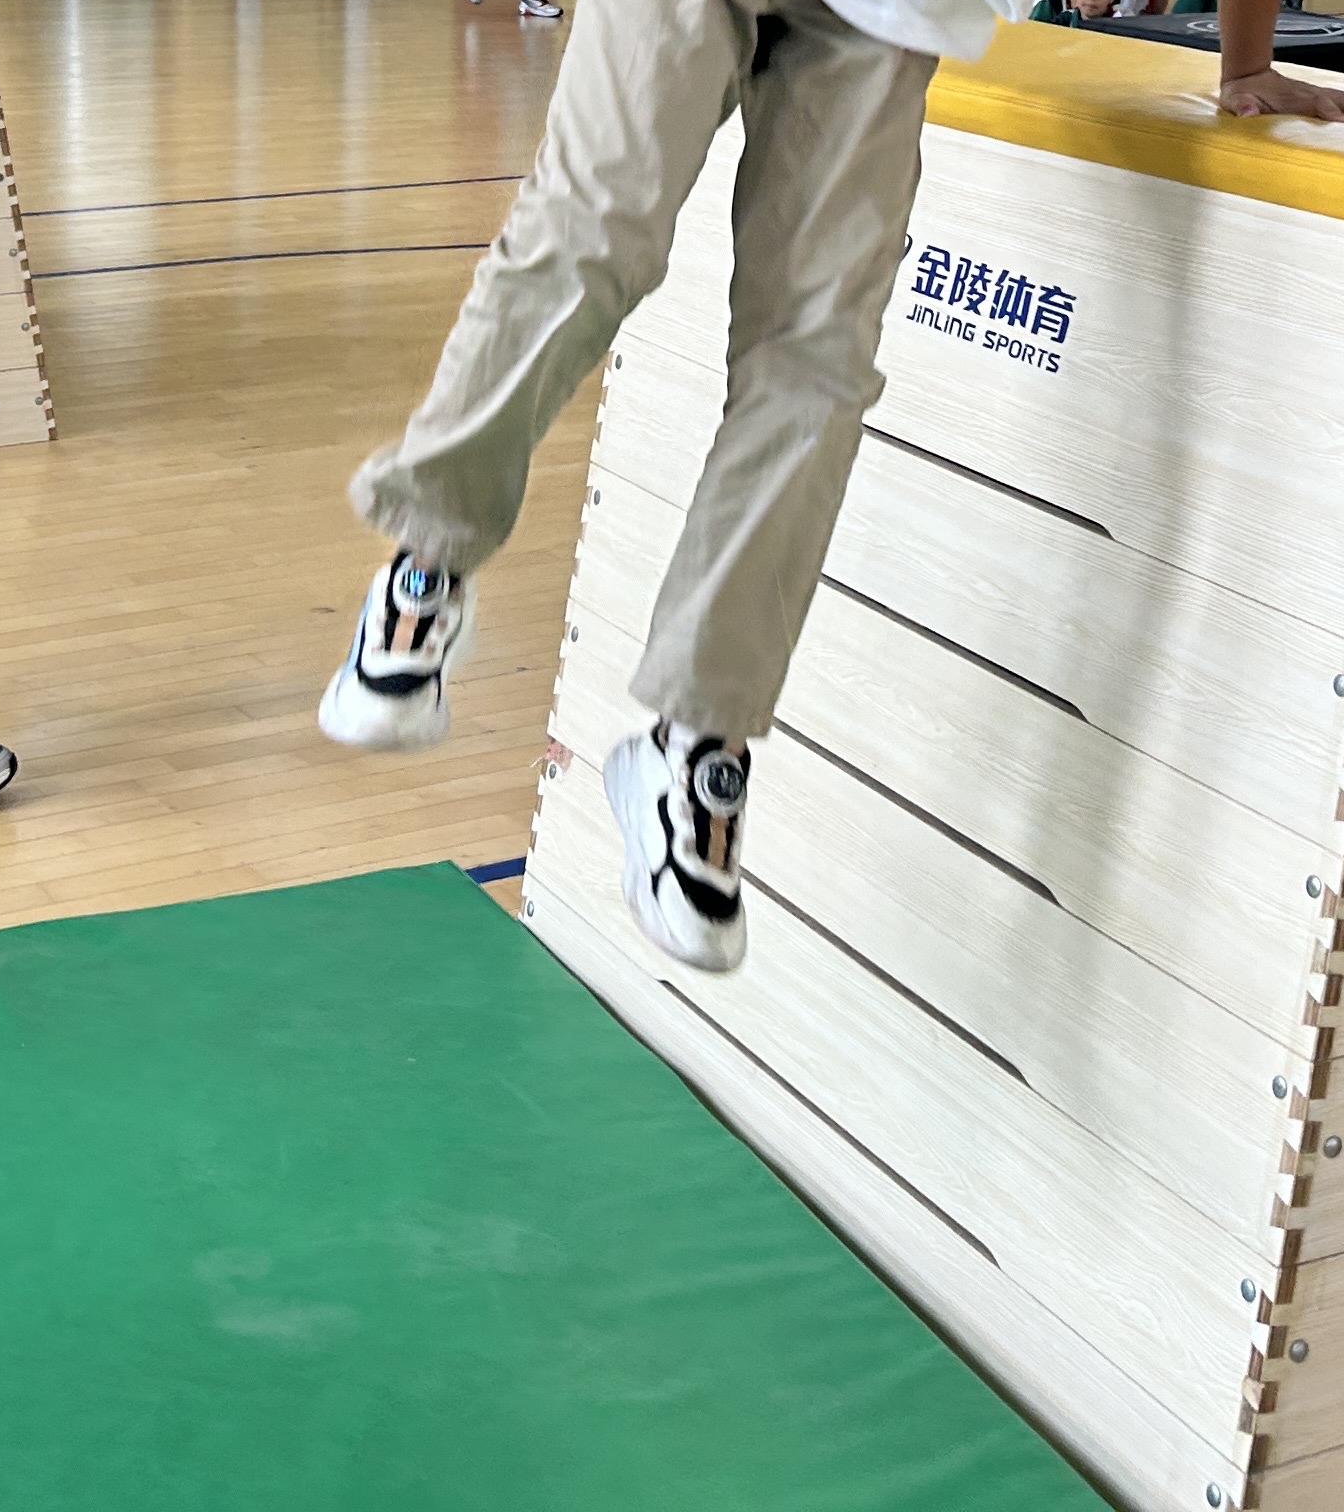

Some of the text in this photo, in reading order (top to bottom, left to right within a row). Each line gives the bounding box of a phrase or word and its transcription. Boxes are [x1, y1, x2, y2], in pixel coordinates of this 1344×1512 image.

[911, 244, 1077, 344] 金陵体育
[982, 330, 1061, 374] SPORTS
